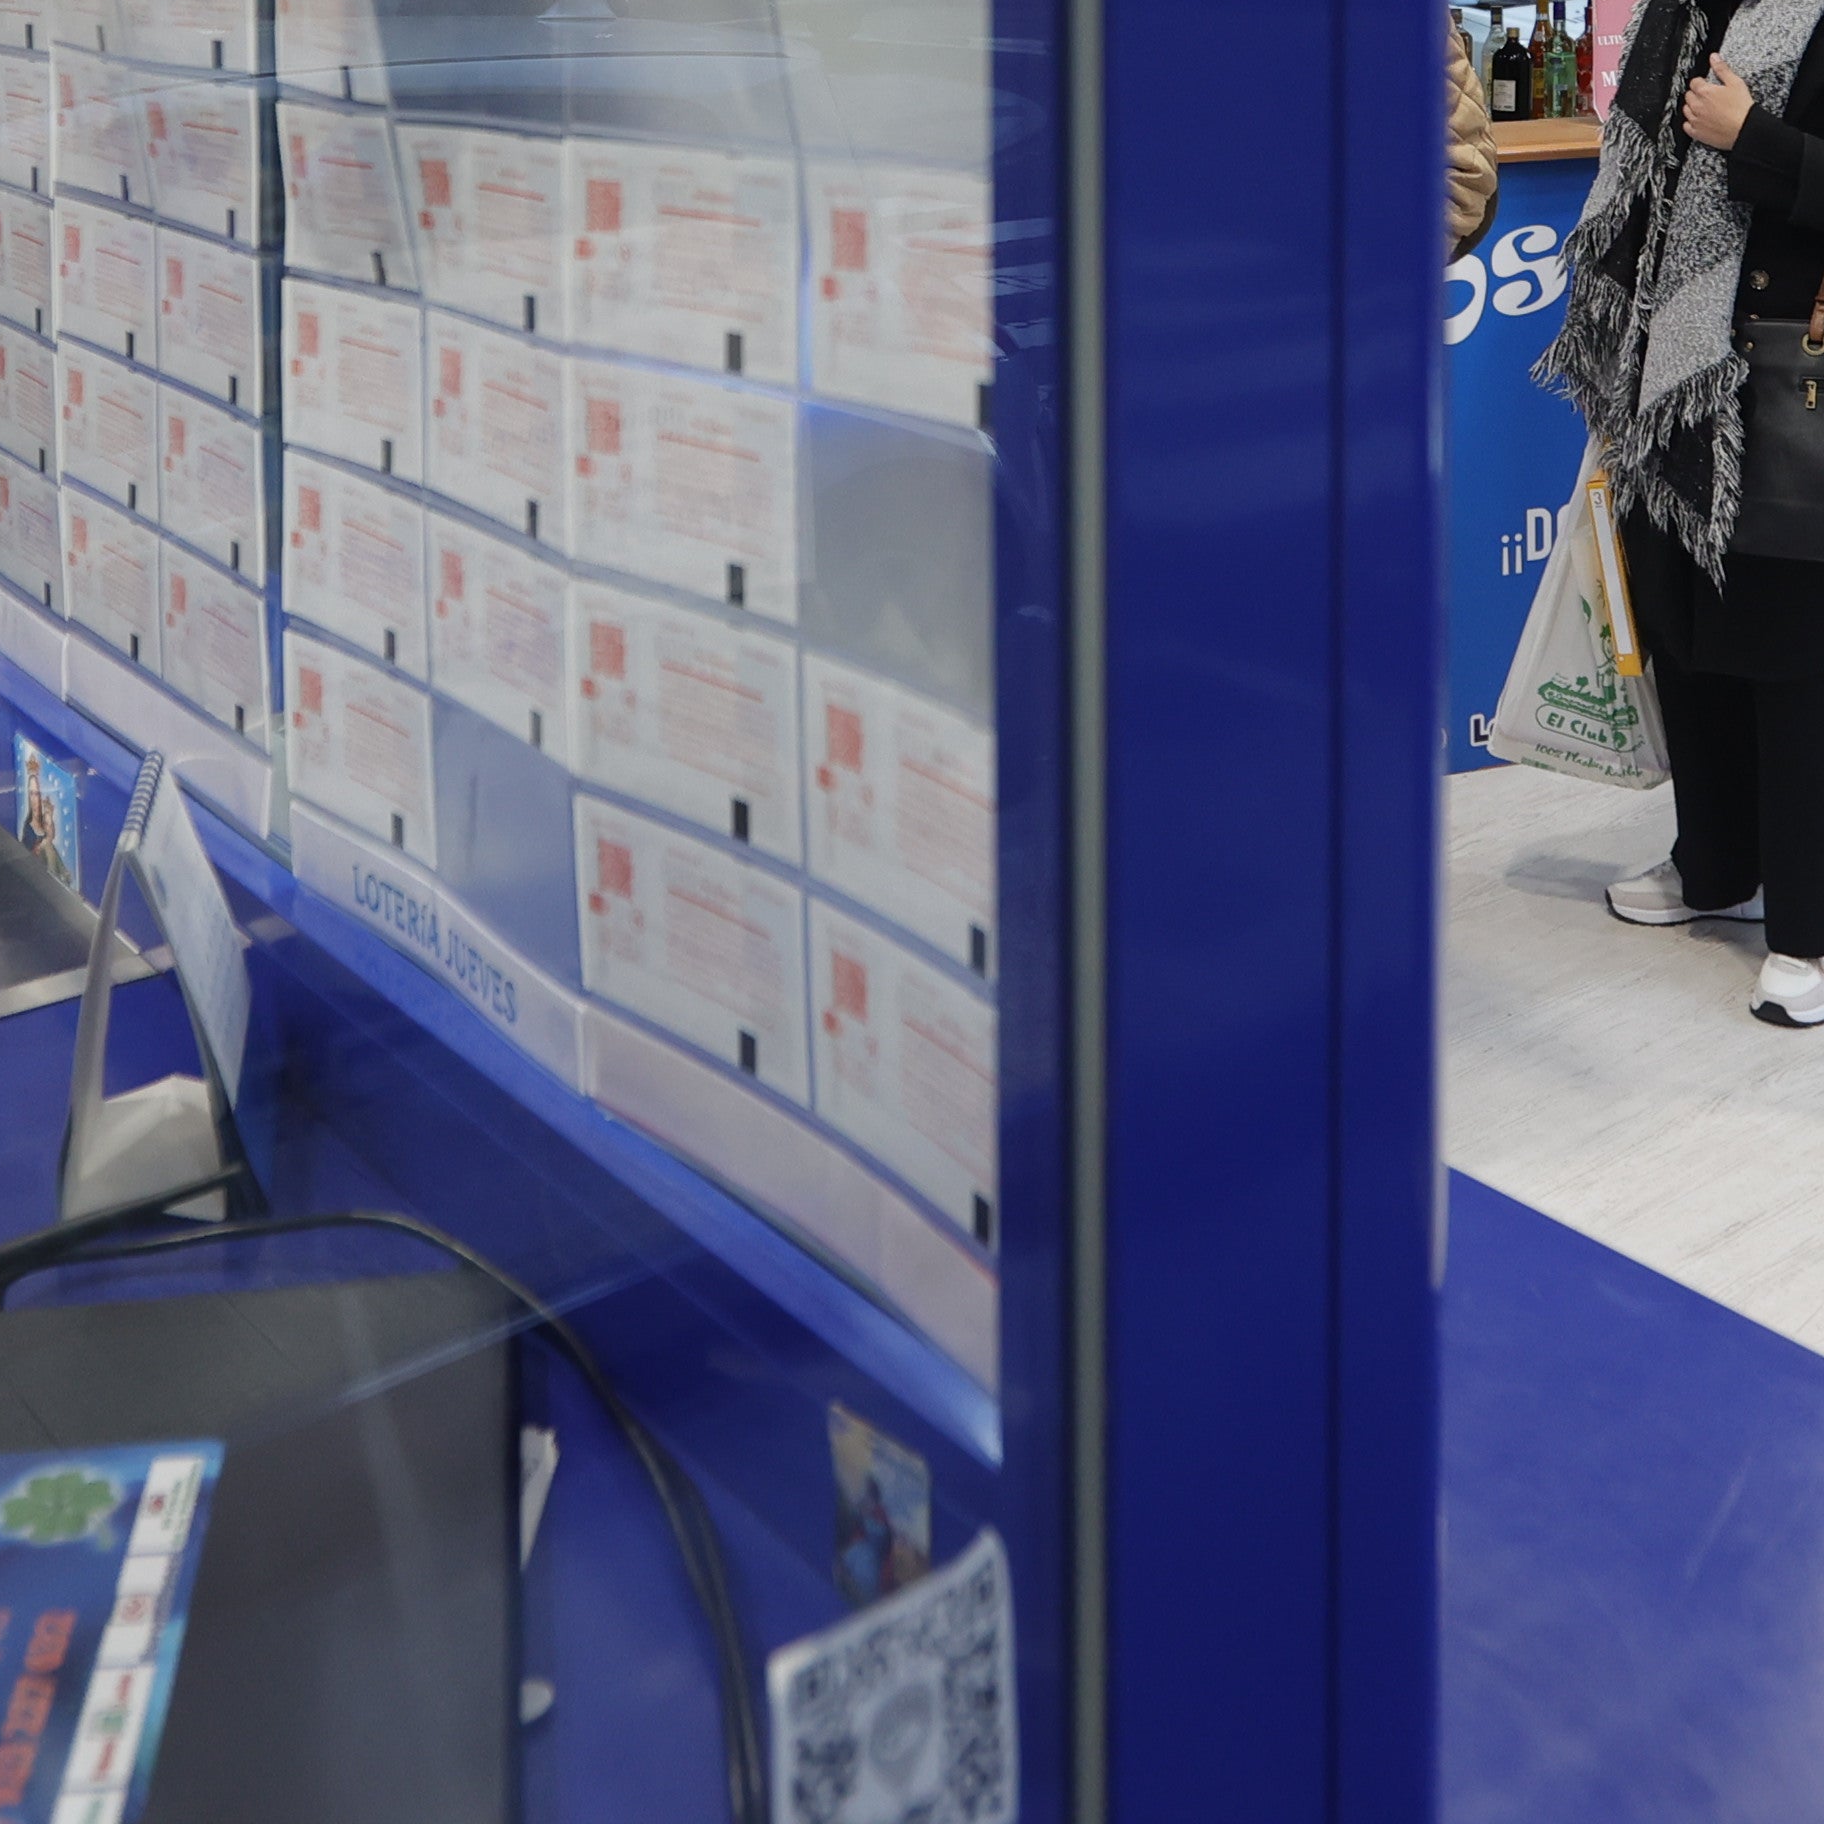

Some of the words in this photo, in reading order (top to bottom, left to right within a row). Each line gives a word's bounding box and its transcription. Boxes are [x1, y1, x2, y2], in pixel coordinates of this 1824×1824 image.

[1546, 711, 1565, 729] El
[1570, 717, 1608, 744] Club
[352, 863, 440, 959] LOTERÍA
[445, 929, 518, 1024] JUEVES
